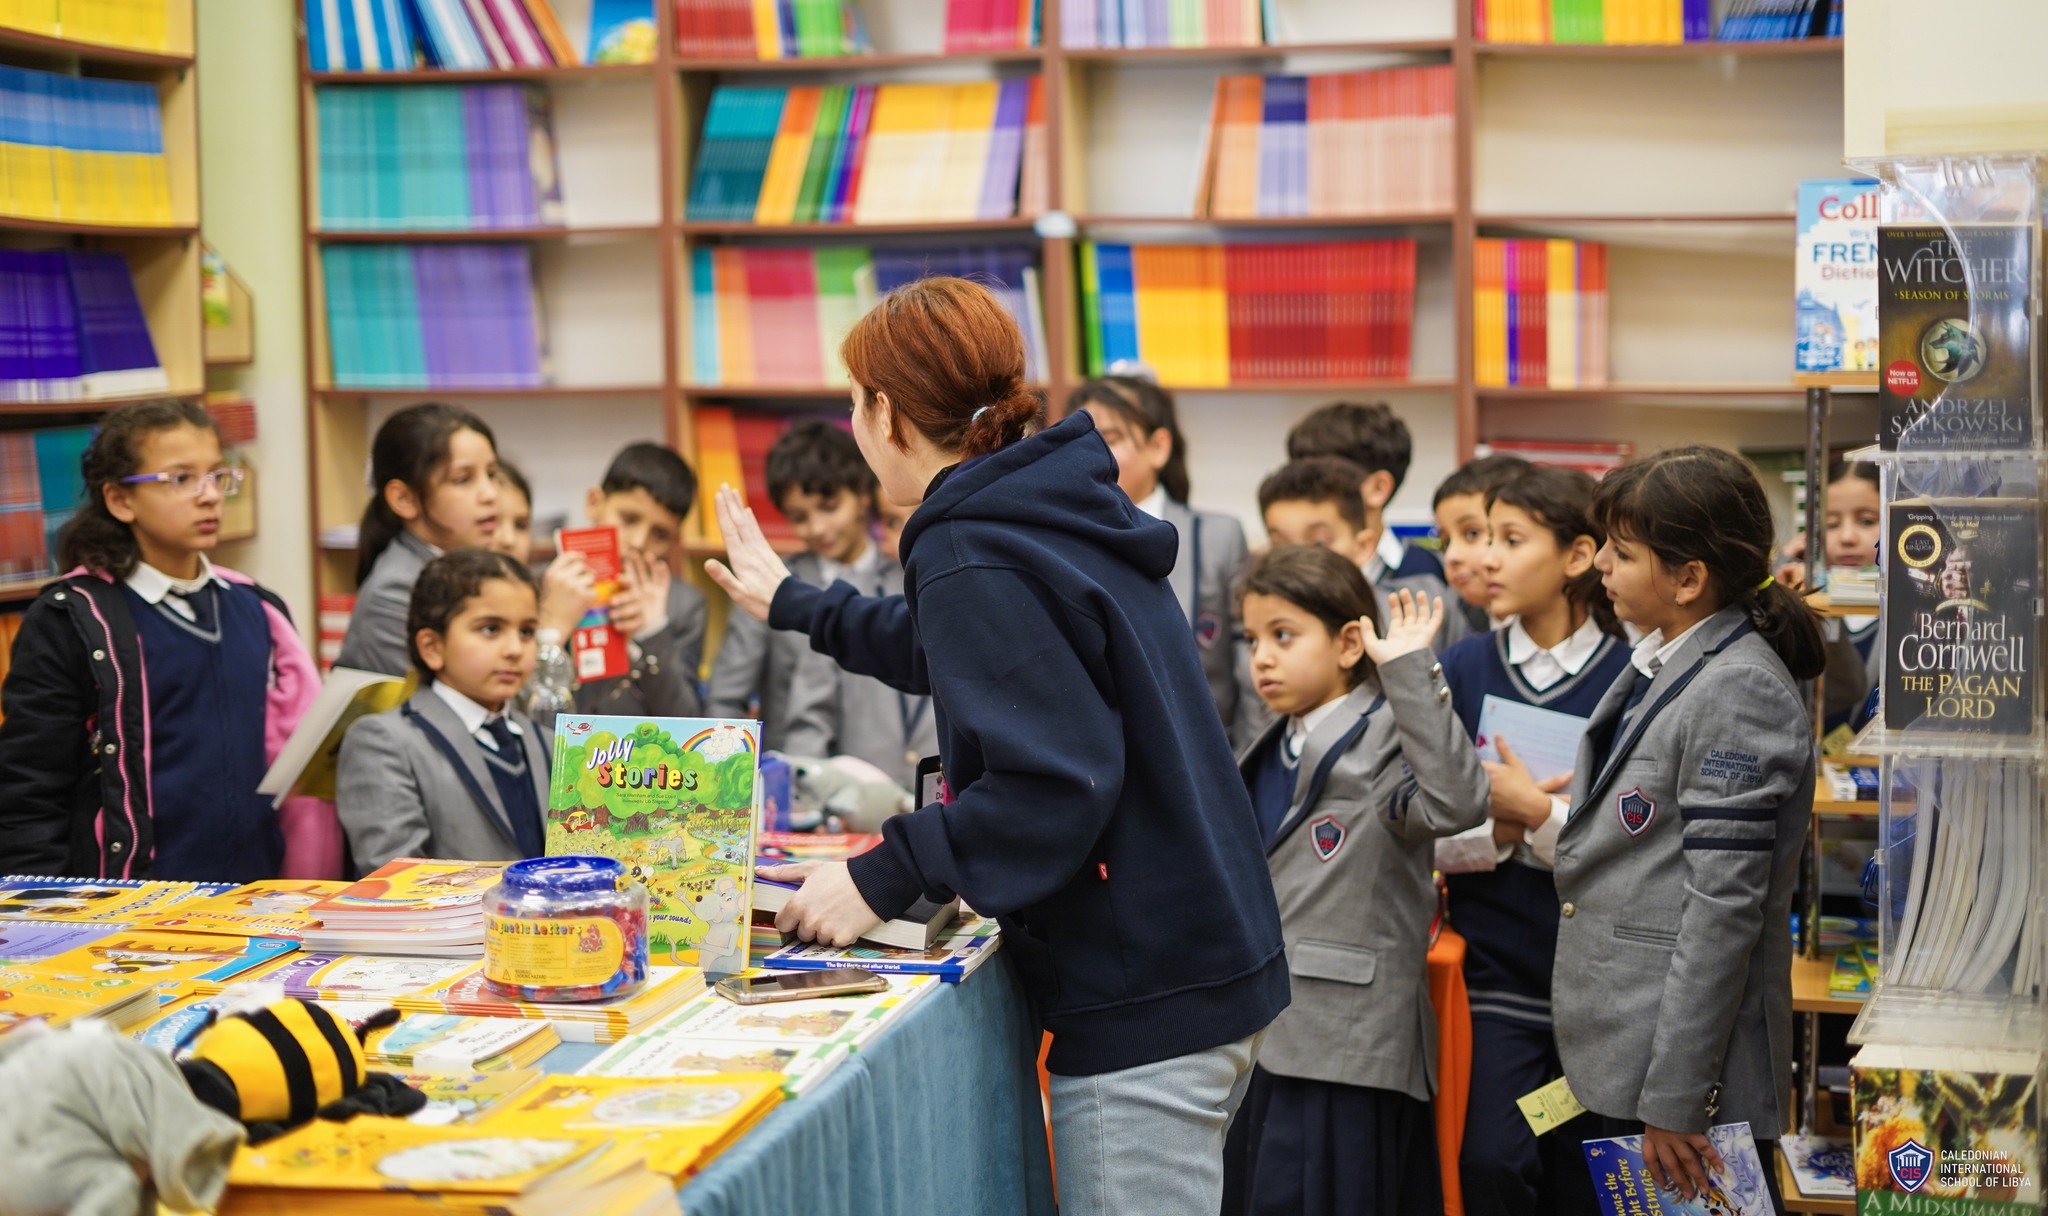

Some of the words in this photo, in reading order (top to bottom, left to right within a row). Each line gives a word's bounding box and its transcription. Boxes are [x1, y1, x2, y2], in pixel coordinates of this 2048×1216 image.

[1818, 193, 1878, 220] Coll
[1813, 243, 1878, 264] FREN
[1929, 239, 1972, 256] THE
[1822, 264, 1878, 281] Dictio
[1883, 248, 2026, 284] WITCHER
[1899, 290, 1942, 300] SEASON
[1945, 290, 1960, 300] OF
[1964, 290, 2009, 300] SORMS
[1905, 398, 2007, 416] ANDRZEJ
[1890, 416, 2023, 434] SAPKOWSKI
[1919, 613, 2006, 641] Bernard
[1898, 634, 2026, 672] Cornwell
[1901, 675, 1934, 692] THE
[1938, 674, 2022, 697] PAGAN
[1926, 697, 1996, 719] LORD
[586, 738, 636, 770] Jolly
[1710, 749, 1758, 764] CALEDONIAN
[1704, 758, 1761, 774] INTERNATIONAL
[596, 761, 698, 792] Stories
[1700, 767, 1728, 778] SCHOOL
[1730, 772, 1741, 780] OF
[1742, 774, 1763, 784] LIBYA
[1626, 810, 1642, 824] CIS
[1319, 838, 1335, 850] CIS
[490, 918, 530, 934] Magnetic
[533, 922, 582, 936] Letters
[653, 914, 668, 922] your
[669, 914, 692, 924] sounds
[1604, 1172, 1618, 1190] the
[1618, 1158, 1638, 1197] Before
[1638, 1169, 1664, 1216] stmas
[1612, 1193, 1626, 1216] was
[1629, 1199, 1649, 1216] ght
[1864, 1190, 1882, 1210] A
[1890, 1193, 2032, 1216] MIDSUMMER
